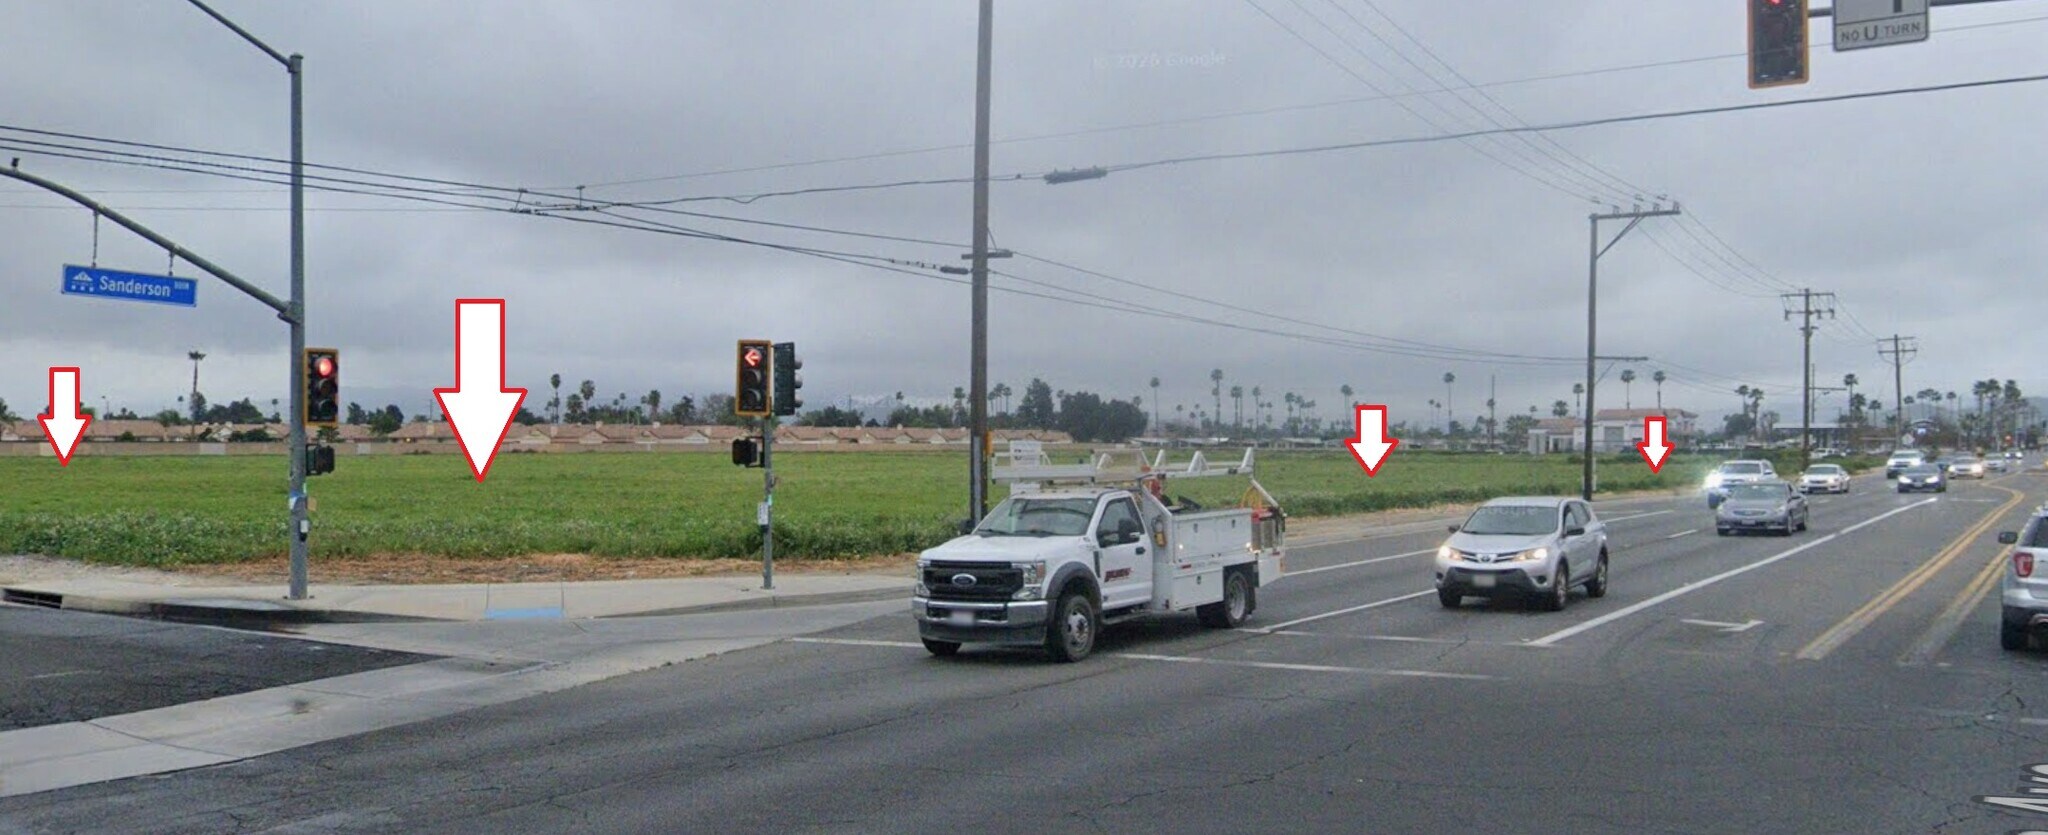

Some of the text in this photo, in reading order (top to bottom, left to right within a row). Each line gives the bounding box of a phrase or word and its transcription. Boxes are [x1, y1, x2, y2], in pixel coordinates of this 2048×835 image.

[1841, 22, 1920, 41] NO U TURN
[99, 275, 171, 297] Sanderson
